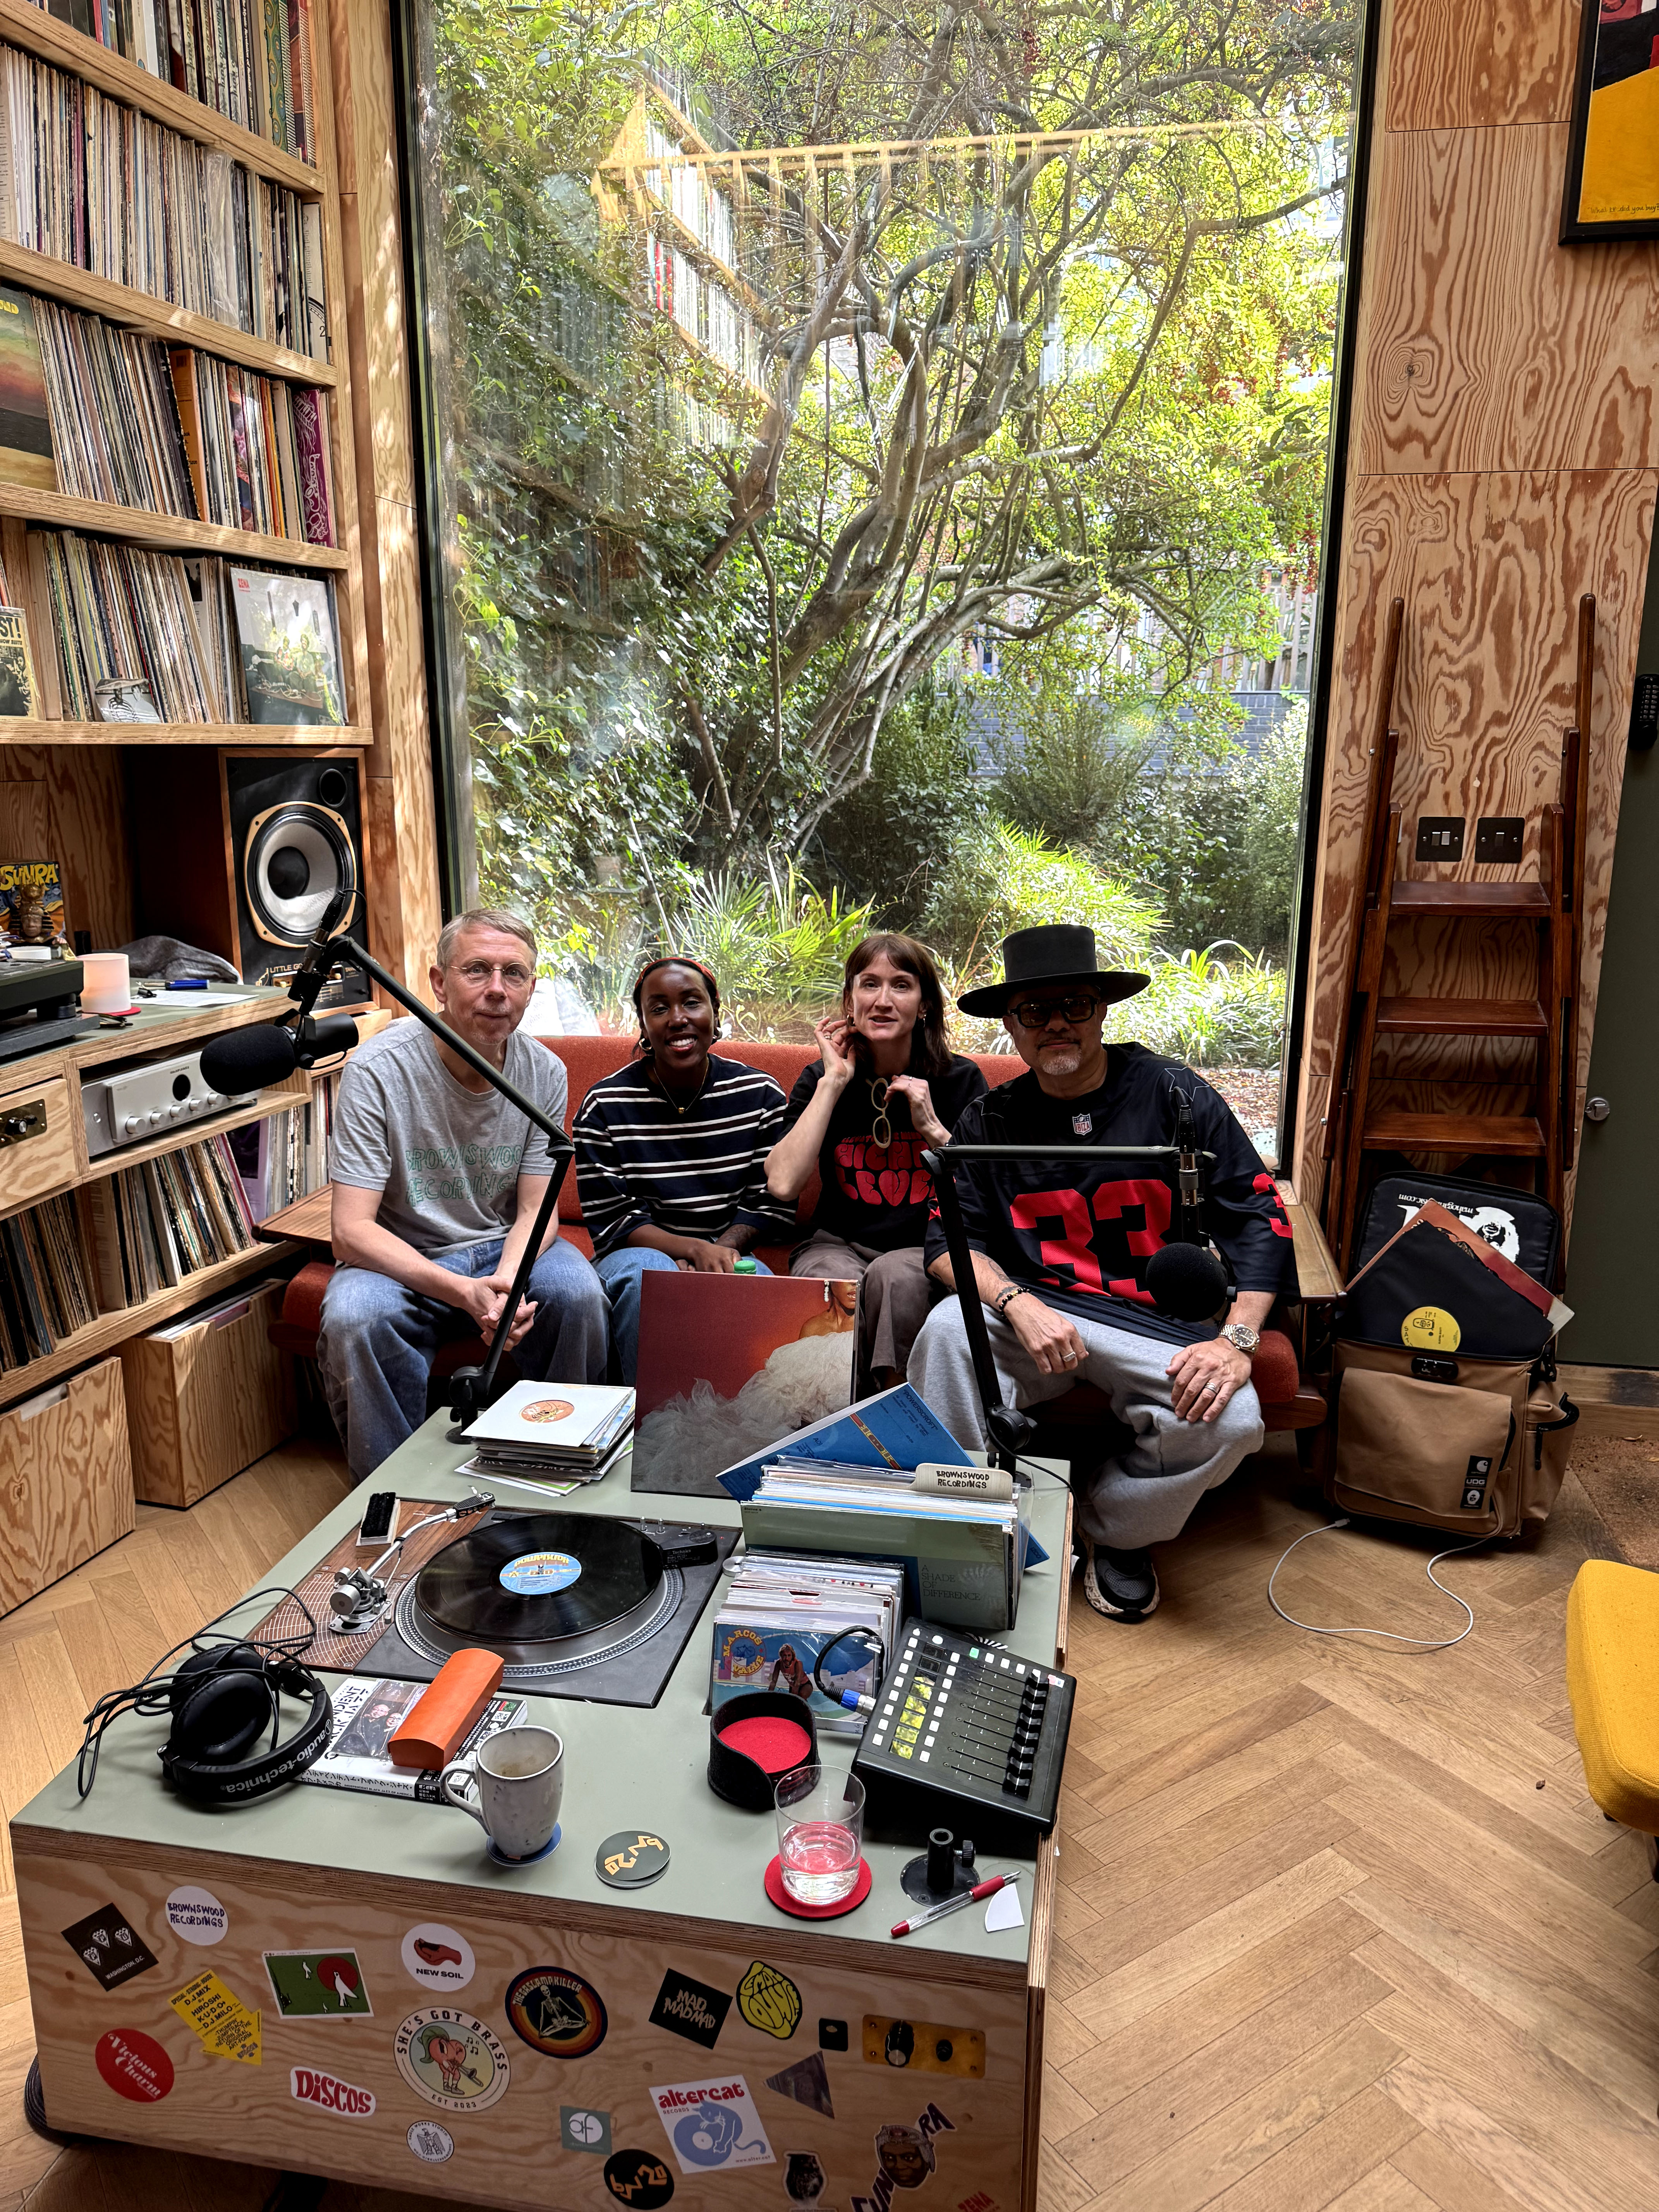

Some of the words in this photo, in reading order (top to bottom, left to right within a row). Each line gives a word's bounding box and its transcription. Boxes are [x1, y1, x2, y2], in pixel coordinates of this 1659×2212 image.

[270, 965, 292, 973] LITTLE
[936, 1470, 989, 1480] BROWNSWOOD
[938, 1479, 987, 1489] RECORDINGS
[922, 1573, 955, 1582] SHADE
[923, 1589, 981, 1601] DIFFERENCE
[723, 1630, 763, 1657] MARCOS
[733, 1655, 764, 1674] VALLE
[226, 1729, 326, 1793] audio-technica
[167, 1902, 225, 1917] BROWNSWOOD
[170, 1913, 223, 1928] RECORDINGS
[105, 1960, 136, 1980] WASHINGTON,
[416, 1968, 439, 1977] NEW
[440, 1971, 464, 1979] SOIL
[554, 1976, 582, 1993] KILLER
[191, 1993, 222, 2017] HIROSHI
[676, 1989, 707, 2011] MAD
[663, 1997, 692, 2020] MAD
[690, 2011, 716, 2030] MAD
[397, 2015, 424, 2055] SHE'S
[430, 2009, 462, 2022] GOT
[471, 2021, 508, 2071] BRASS
[108, 2033, 157, 2078] Vicious
[115, 2056, 161, 2099] Charm
[431, 2094, 448, 2105] EST
[658, 2083, 745, 2109] altercat
[663, 2107, 690, 2115] RECORDS
[919, 2102, 956, 2137] RA
